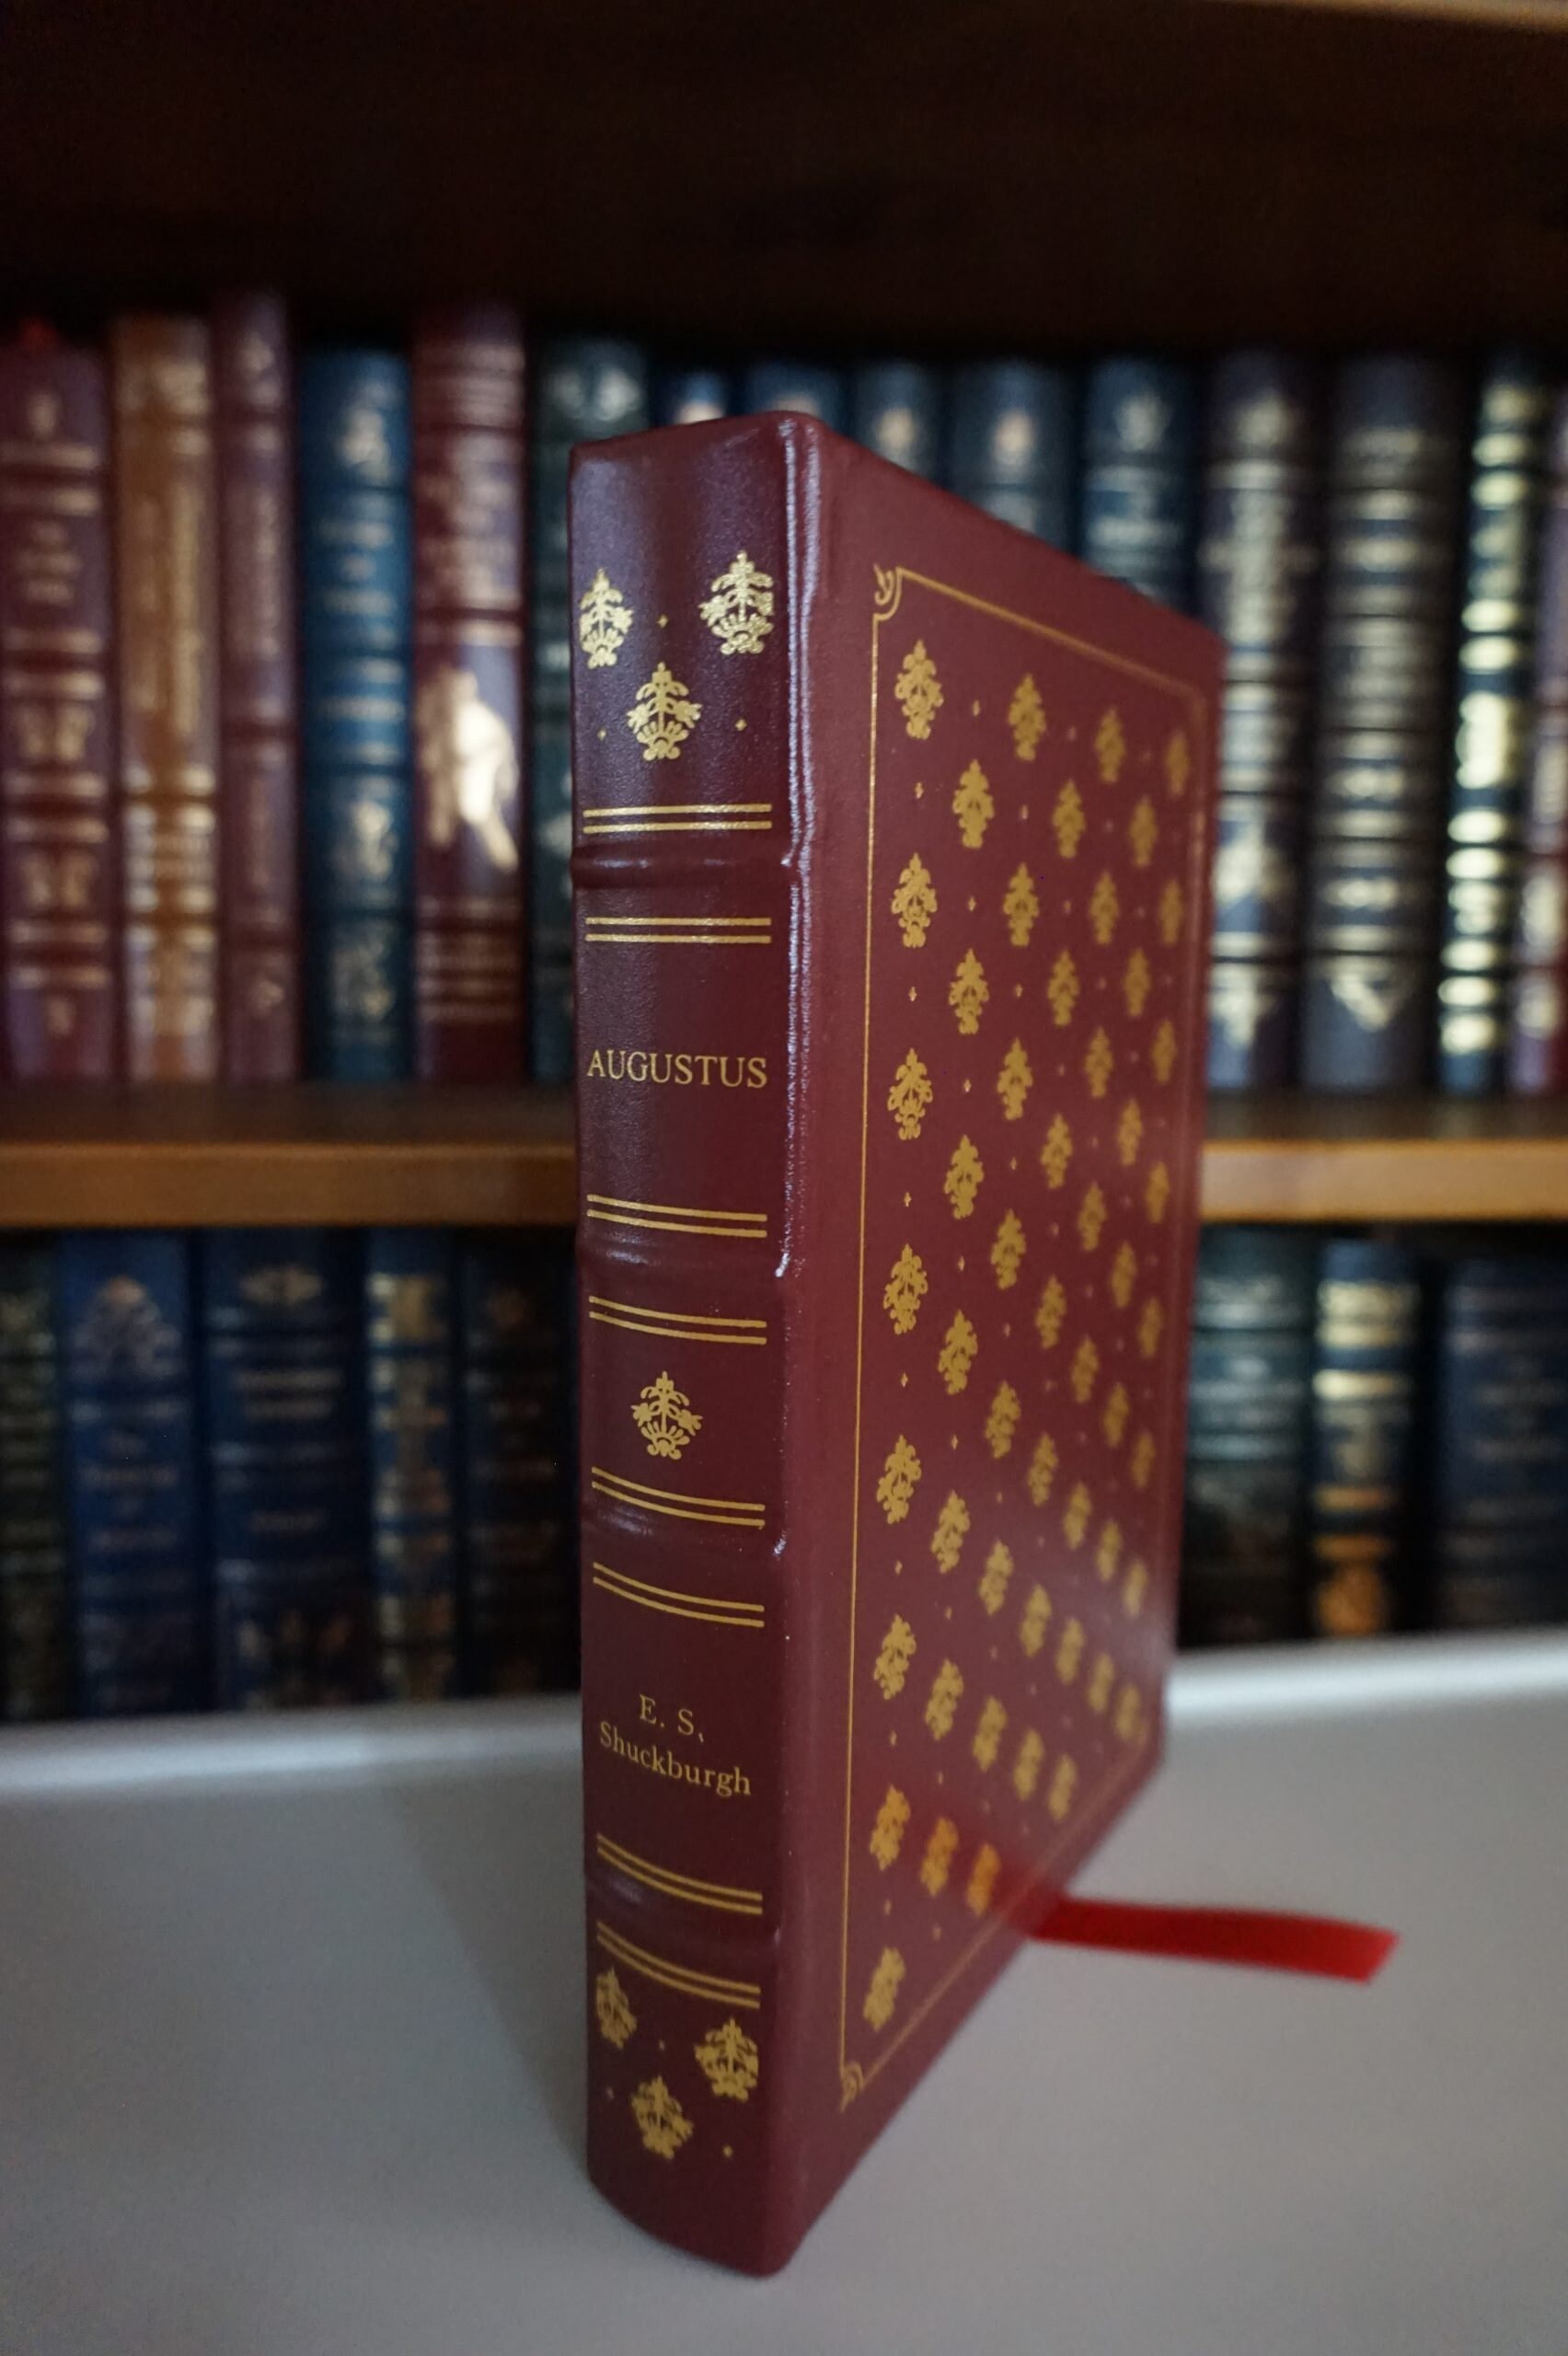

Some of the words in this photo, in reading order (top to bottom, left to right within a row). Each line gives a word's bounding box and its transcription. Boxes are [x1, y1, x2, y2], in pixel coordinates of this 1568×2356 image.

[586, 1049, 768, 1089] AUGUSTUS
[640, 1693, 665, 1728] E.
[599, 1720, 752, 1797] Shuckburgh
